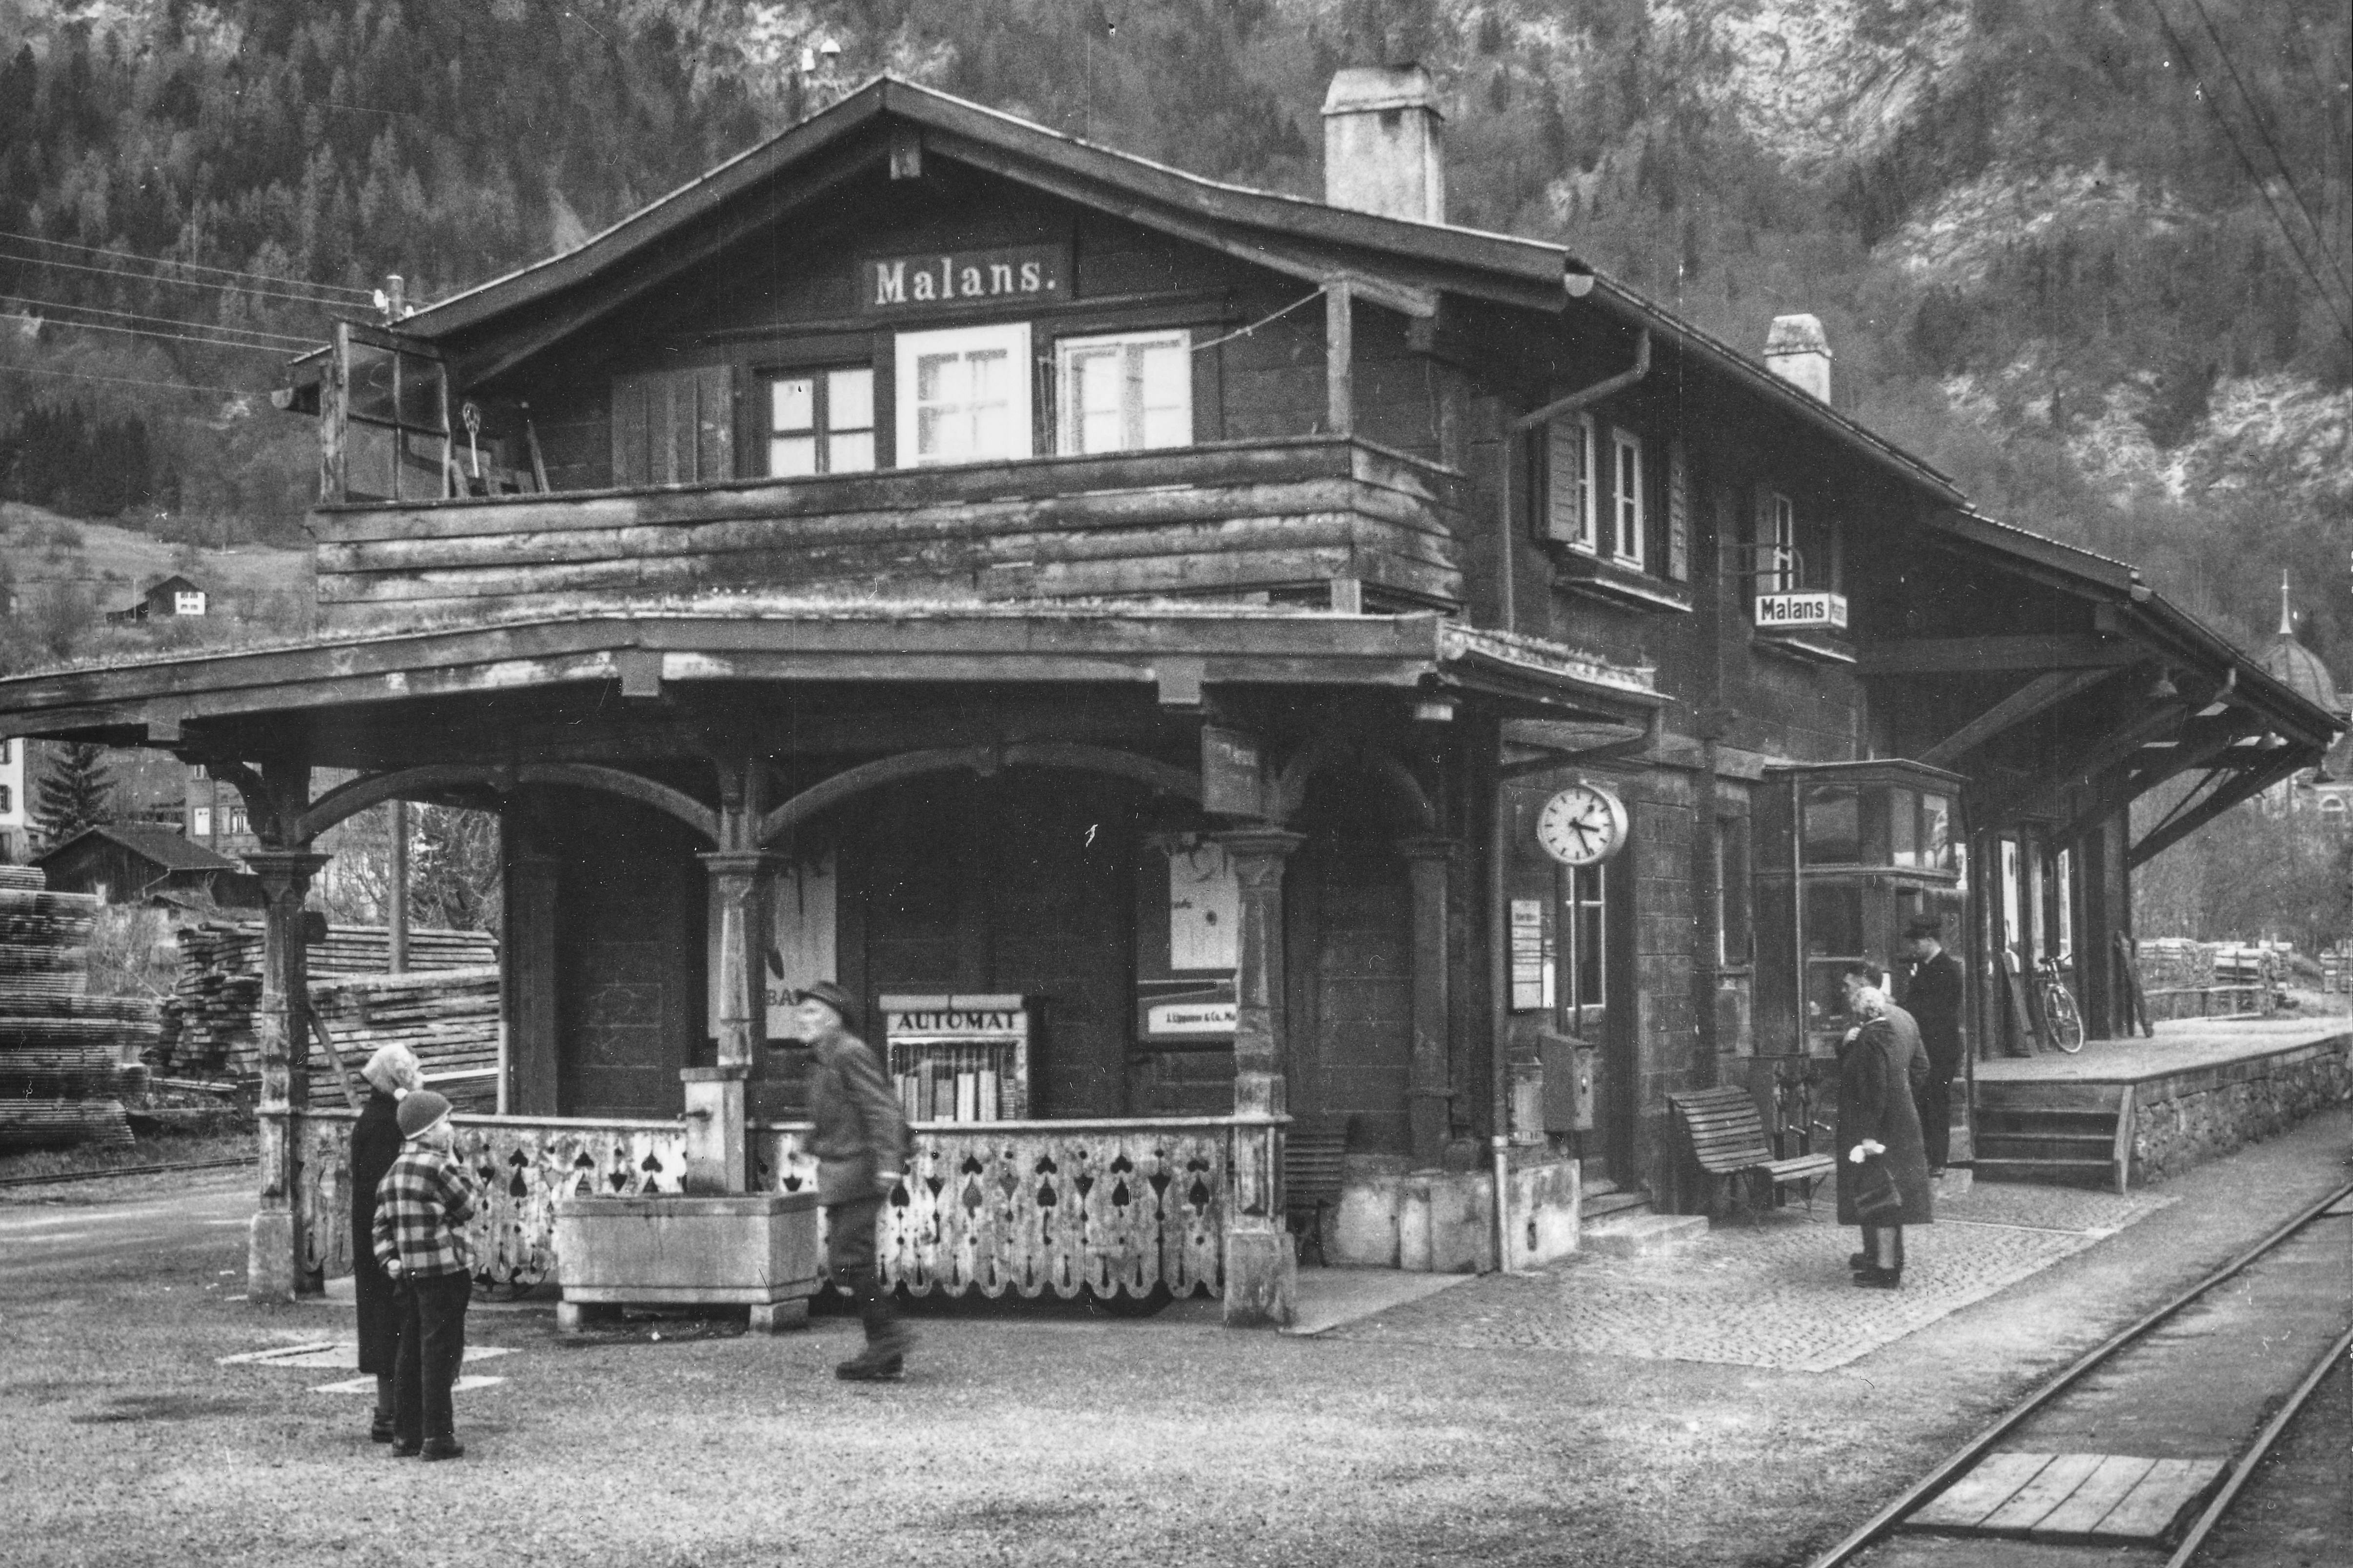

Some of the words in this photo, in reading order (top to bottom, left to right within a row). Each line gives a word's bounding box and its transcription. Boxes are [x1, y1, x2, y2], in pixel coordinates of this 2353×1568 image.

[875, 257, 1056, 304] Malans.
[1761, 597, 1824, 620] Malans
[897, 1011, 1016, 1029] AUTOMAT
